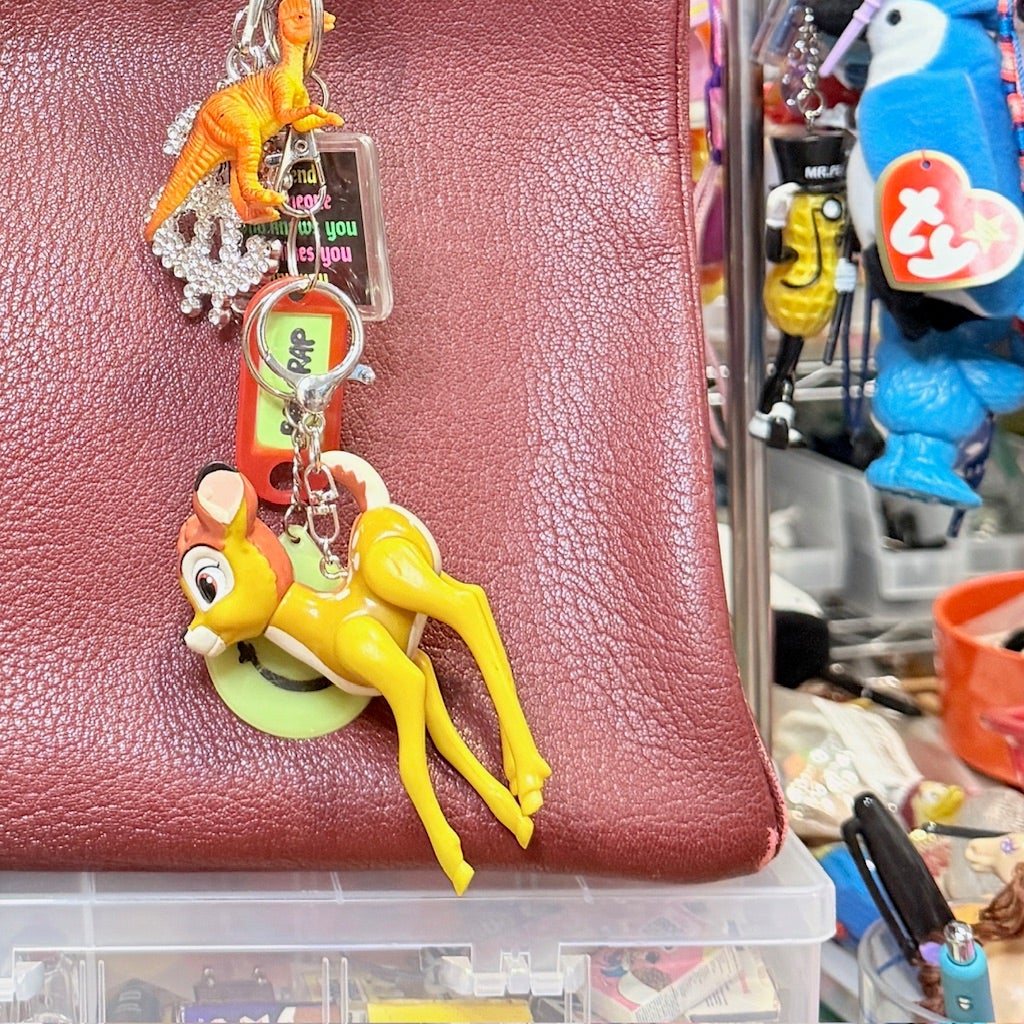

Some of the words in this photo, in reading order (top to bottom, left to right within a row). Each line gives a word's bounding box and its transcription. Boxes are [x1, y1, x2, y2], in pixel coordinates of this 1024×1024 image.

[325, 220, 357, 241] you
[320, 245, 352, 268] you
[287, 327, 315, 376] RAP
